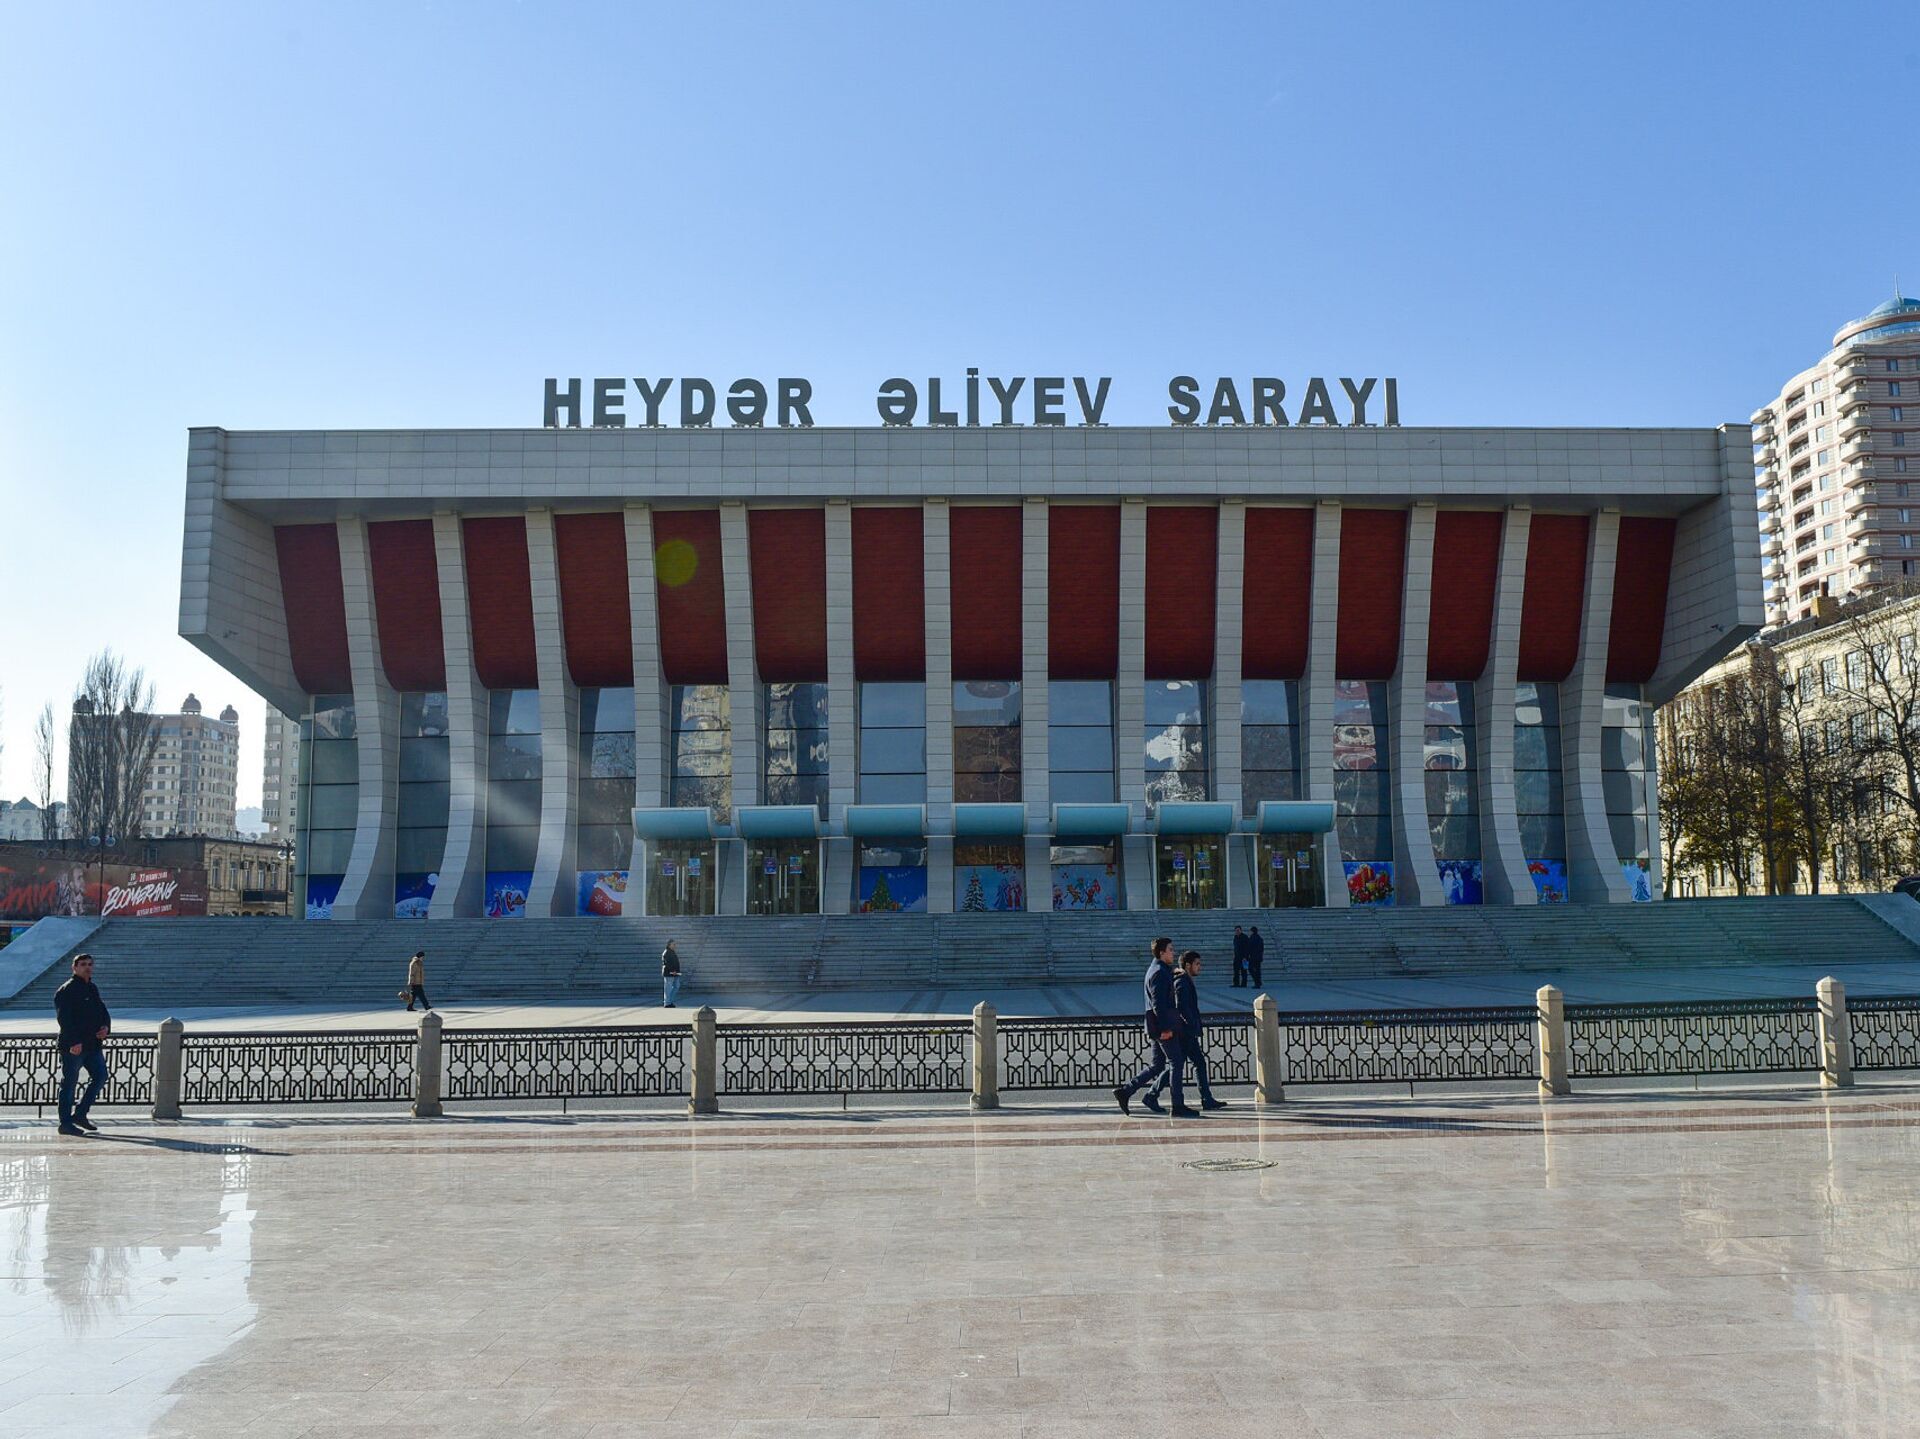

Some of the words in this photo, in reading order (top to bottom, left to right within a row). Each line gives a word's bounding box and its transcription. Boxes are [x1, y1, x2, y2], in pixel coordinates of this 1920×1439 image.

[543, 378, 814, 425] HEYDƏR
[877, 368, 1111, 425] ƏLİYEV
[1168, 375, 1399, 425] SARAYI
[102, 880, 178, 916] BOOMERANG
